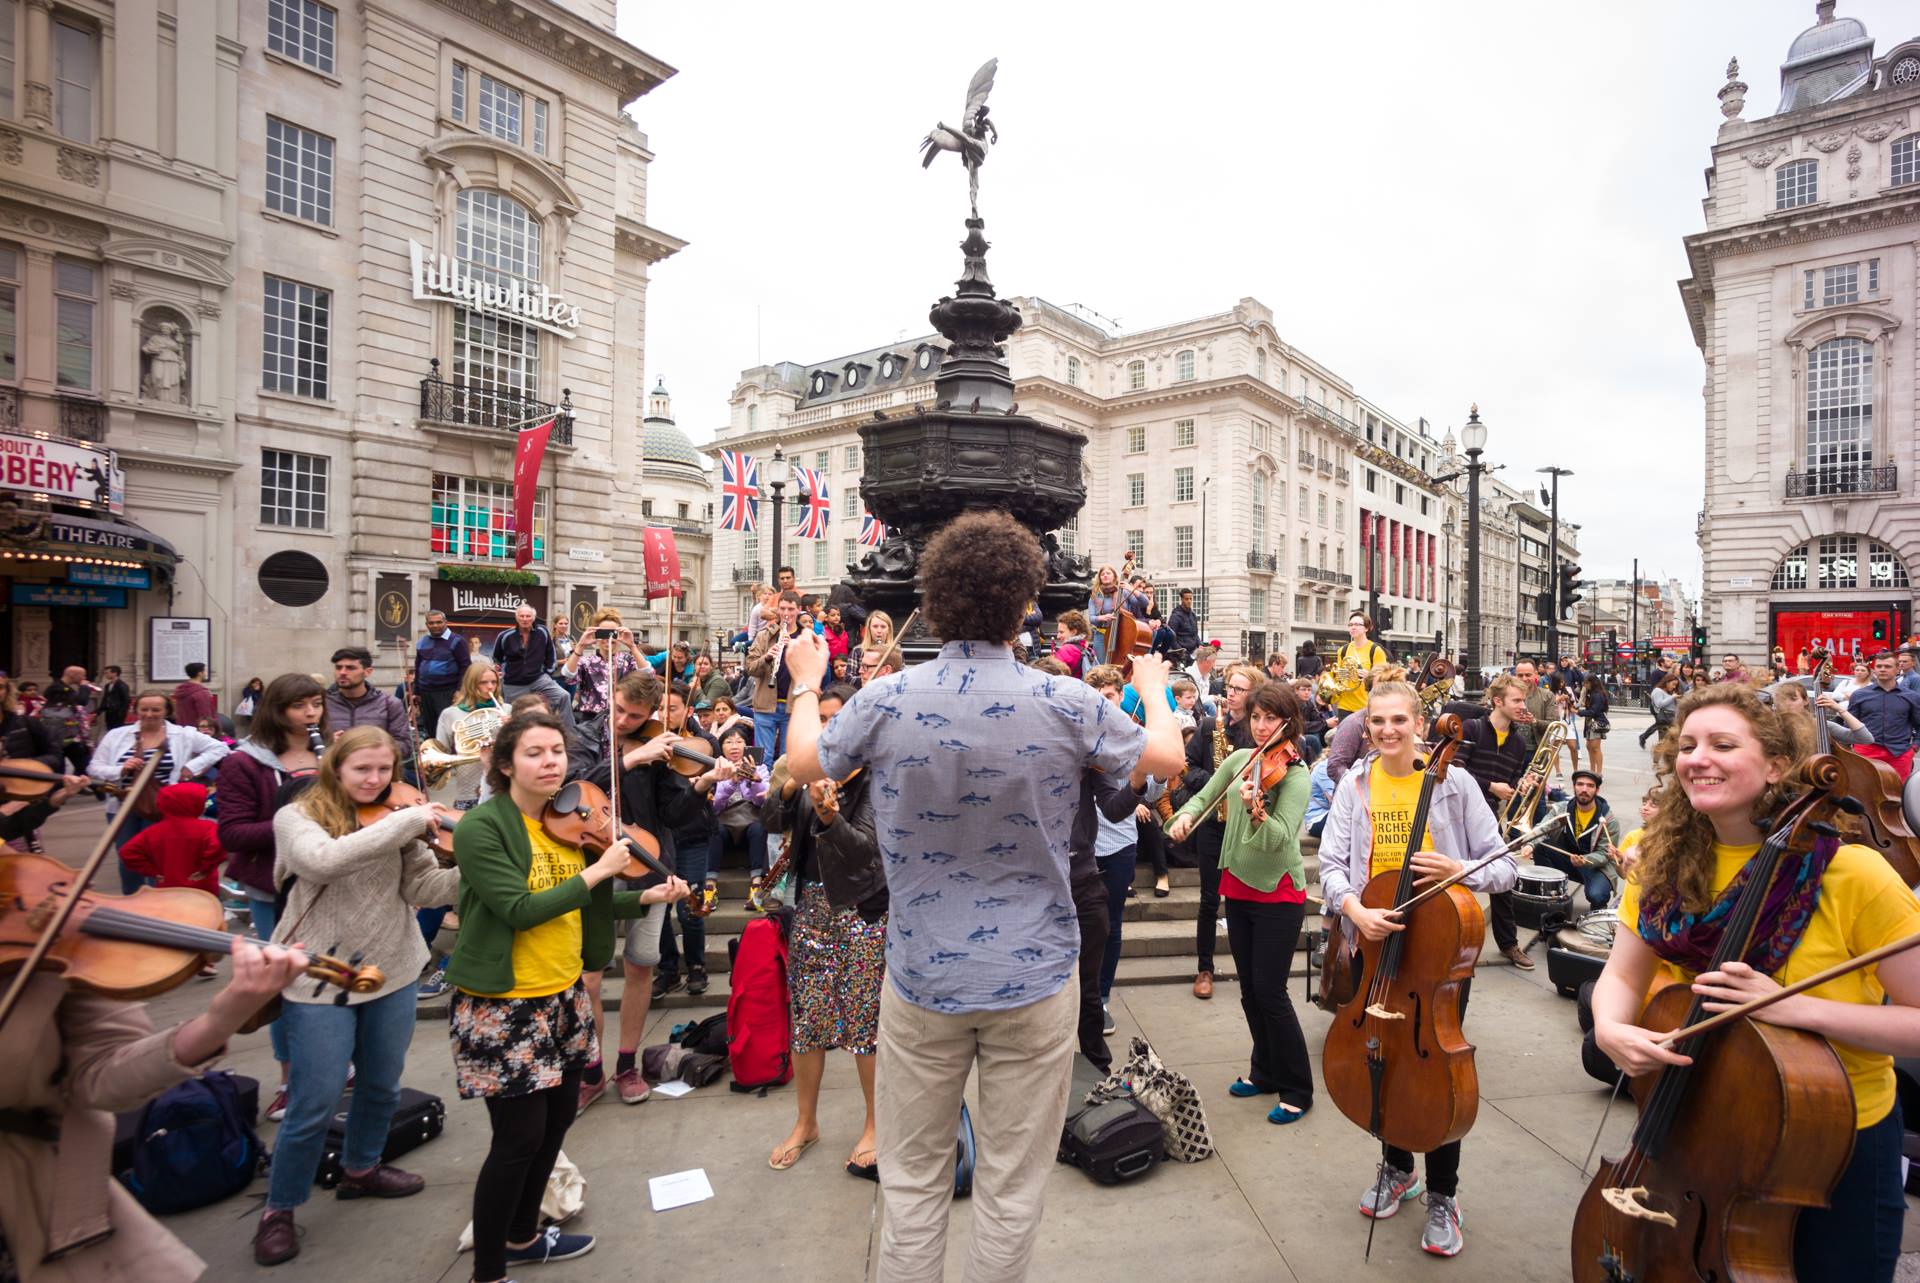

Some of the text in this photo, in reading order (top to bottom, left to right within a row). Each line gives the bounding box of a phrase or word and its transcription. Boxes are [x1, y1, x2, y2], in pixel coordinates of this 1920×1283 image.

[409, 237, 582, 339] Lillywhites
[36, 445, 45, 458] A
[0, 453, 77, 492] BERY
[53, 525, 135, 549] THEATRE
[1832, 559, 1892, 580] Stng
[452, 586, 528, 612] Lillywhites
[1371, 811, 1409, 822] STREET
[1375, 822, 1412, 833] RCHES
[1374, 833, 1410, 845] ONDO
[532, 852, 560, 864] TREET
